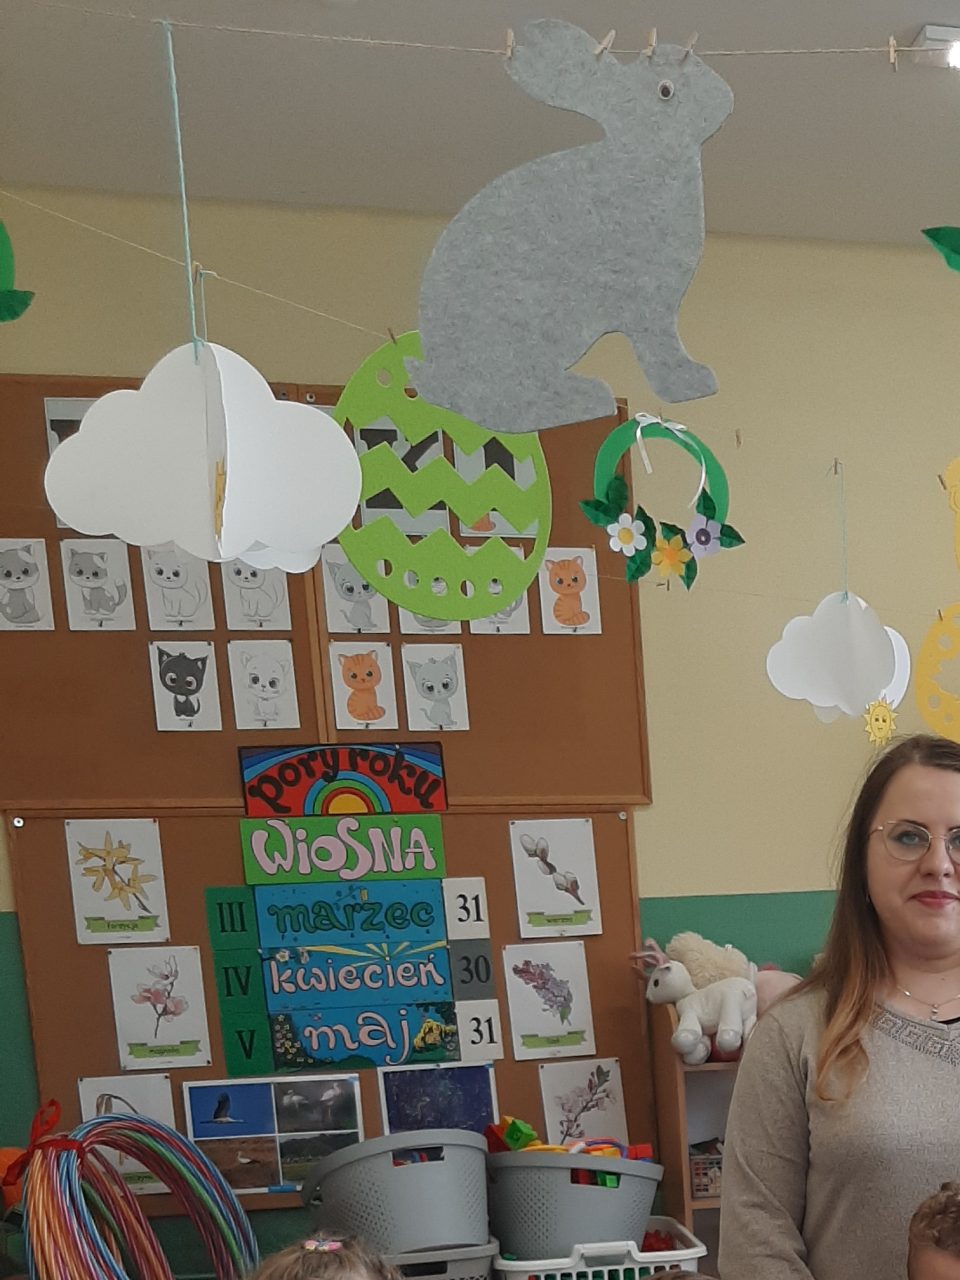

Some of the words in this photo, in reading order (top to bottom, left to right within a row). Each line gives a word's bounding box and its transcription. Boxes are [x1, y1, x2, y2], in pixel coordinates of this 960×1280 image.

[349, 748, 442, 809] roku
[216, 902, 247, 933] III
[268, 900, 435, 934] marzec
[457, 894, 484, 923] 31
[223, 966, 252, 997] IV
[269, 954, 445, 994] kwiecień
[460, 954, 491, 985] 30
[235, 1029, 256, 1060] V
[303, 1009, 411, 1066] maj
[470, 1017, 498, 1046] 31
